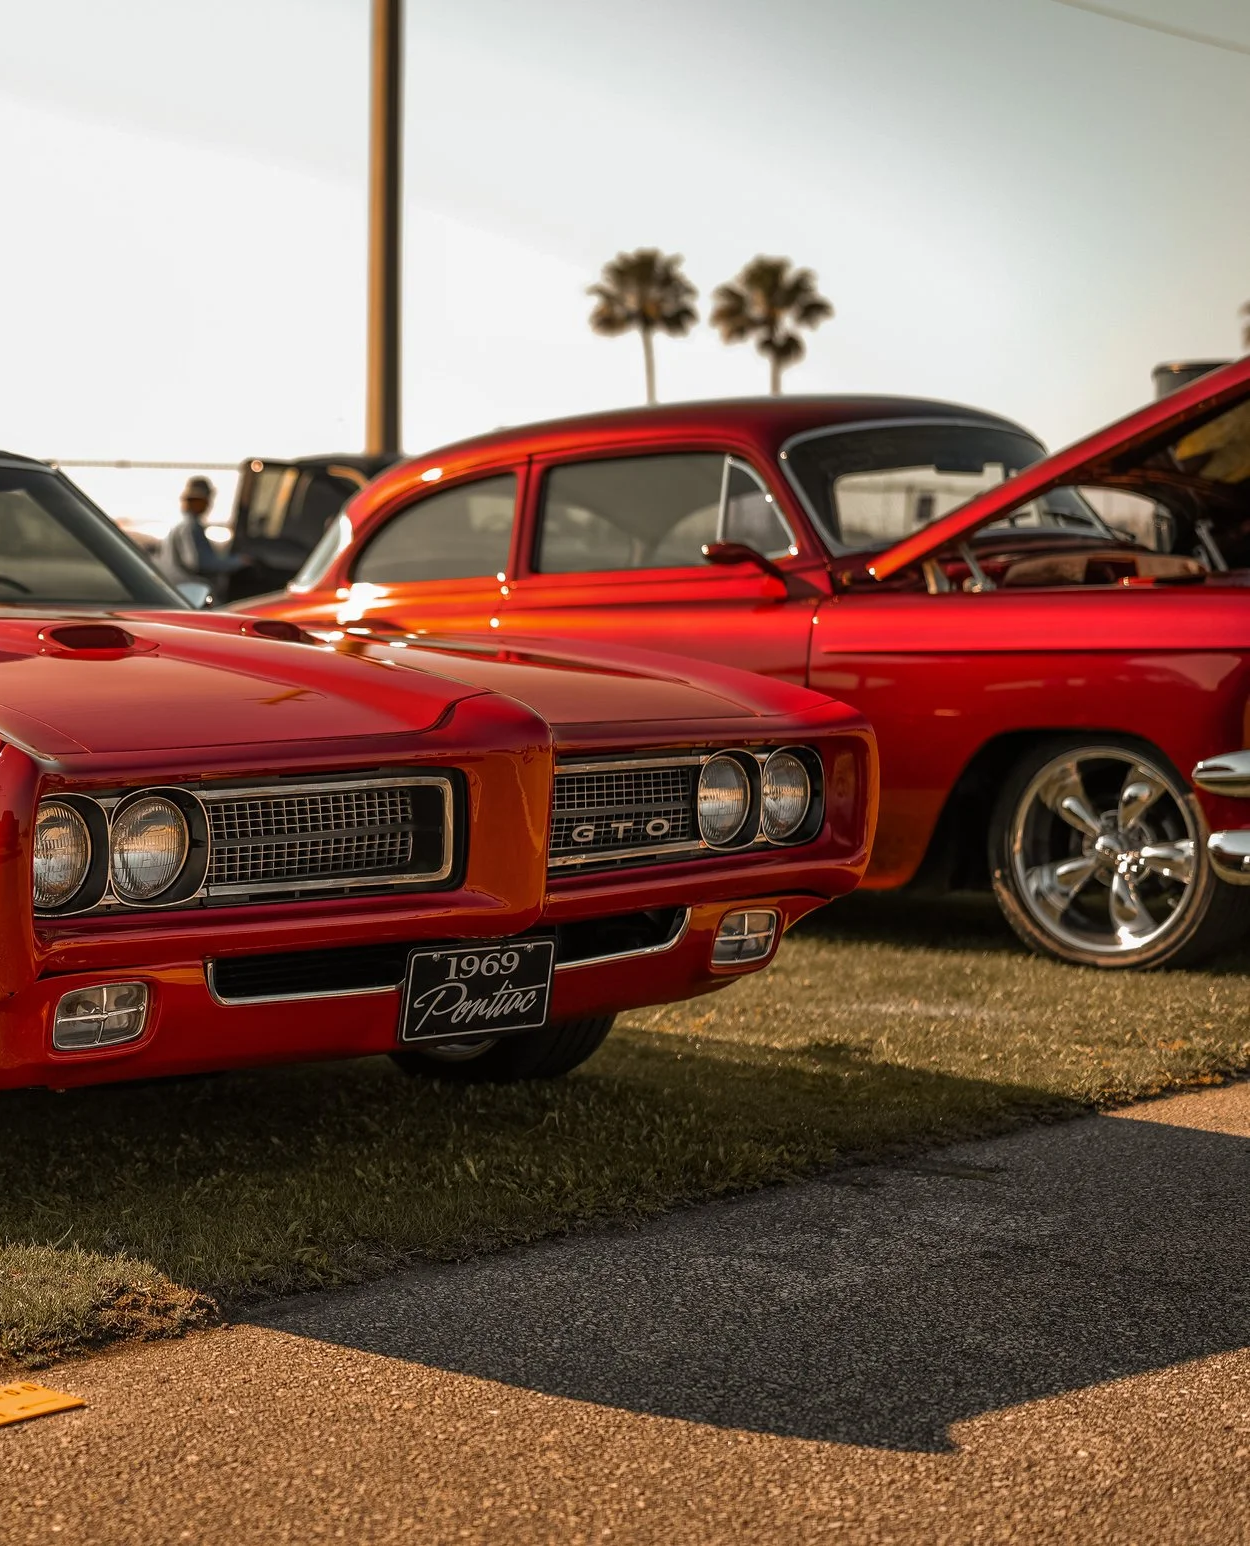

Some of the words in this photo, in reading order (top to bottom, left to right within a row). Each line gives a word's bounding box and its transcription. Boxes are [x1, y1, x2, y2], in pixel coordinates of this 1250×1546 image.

[571, 817, 670, 842] GTO
[444, 951, 520, 981] 1969
[413, 979, 547, 1032] Pontiac
